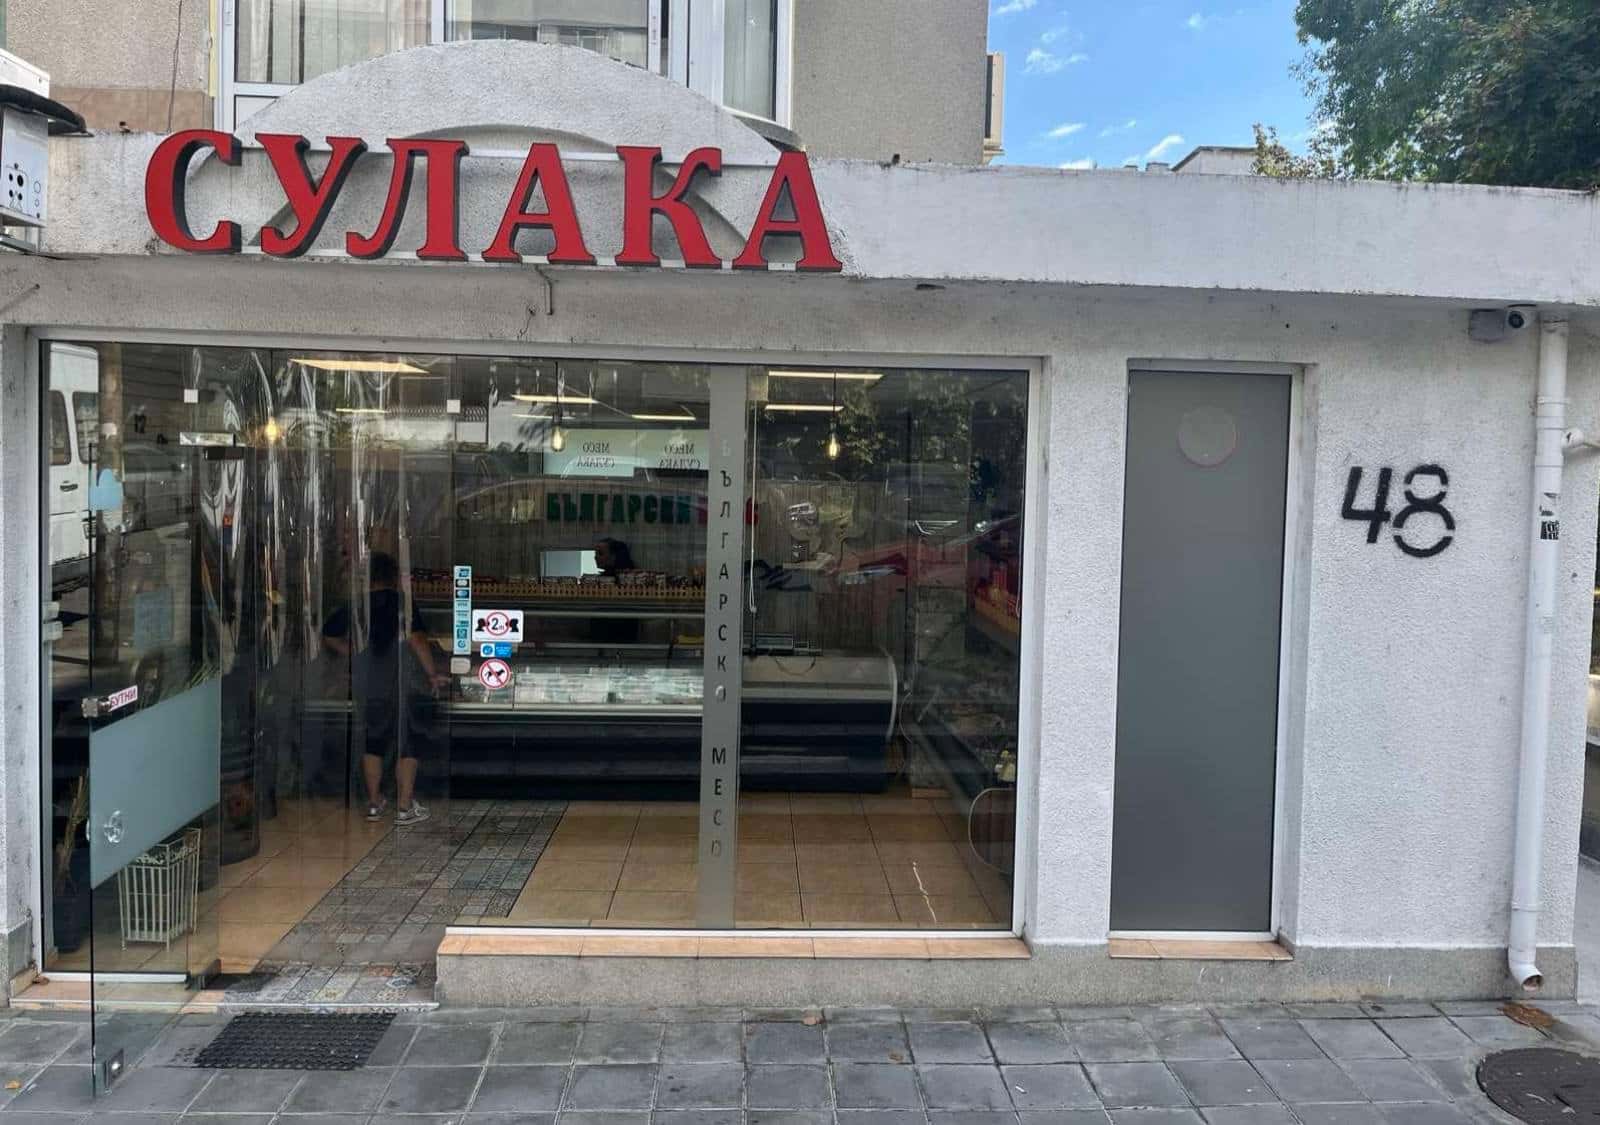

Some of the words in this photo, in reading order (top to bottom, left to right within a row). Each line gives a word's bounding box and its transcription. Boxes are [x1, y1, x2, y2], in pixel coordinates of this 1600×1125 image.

[145, 128, 842, 271] СУЛАКА
[1342, 463, 1455, 558] 48
[110, 687, 136, 708] БУТНИ
